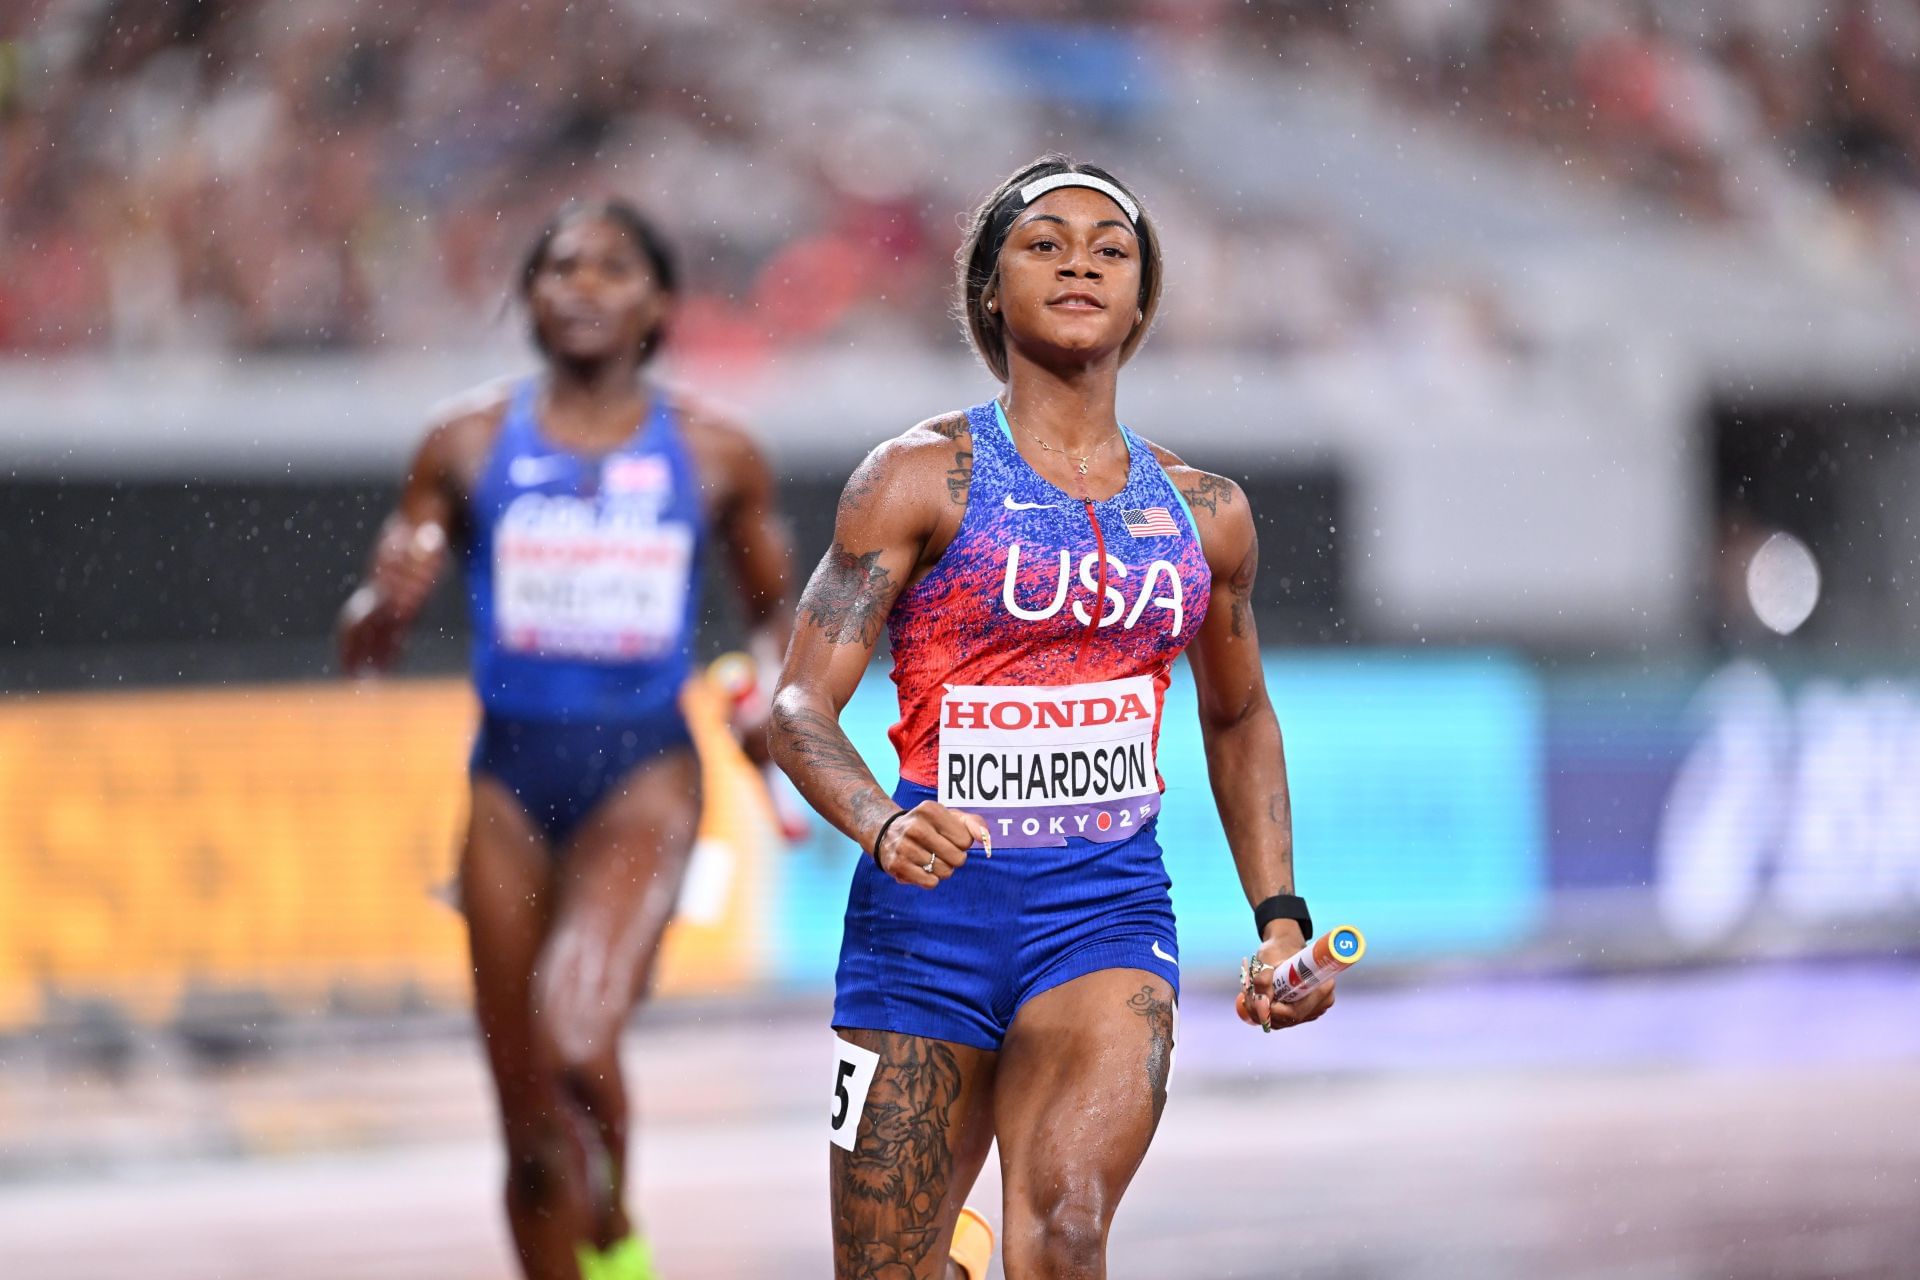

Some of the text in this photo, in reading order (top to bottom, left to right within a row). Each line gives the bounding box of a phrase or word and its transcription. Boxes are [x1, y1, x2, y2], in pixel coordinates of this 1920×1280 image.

[1003, 544, 1184, 637] USA
[944, 693, 1151, 730] HONDA
[948, 742, 1147, 801] RICHARDSON
[1339, 939, 1353, 950] 5
[831, 1059, 856, 1131] 5
